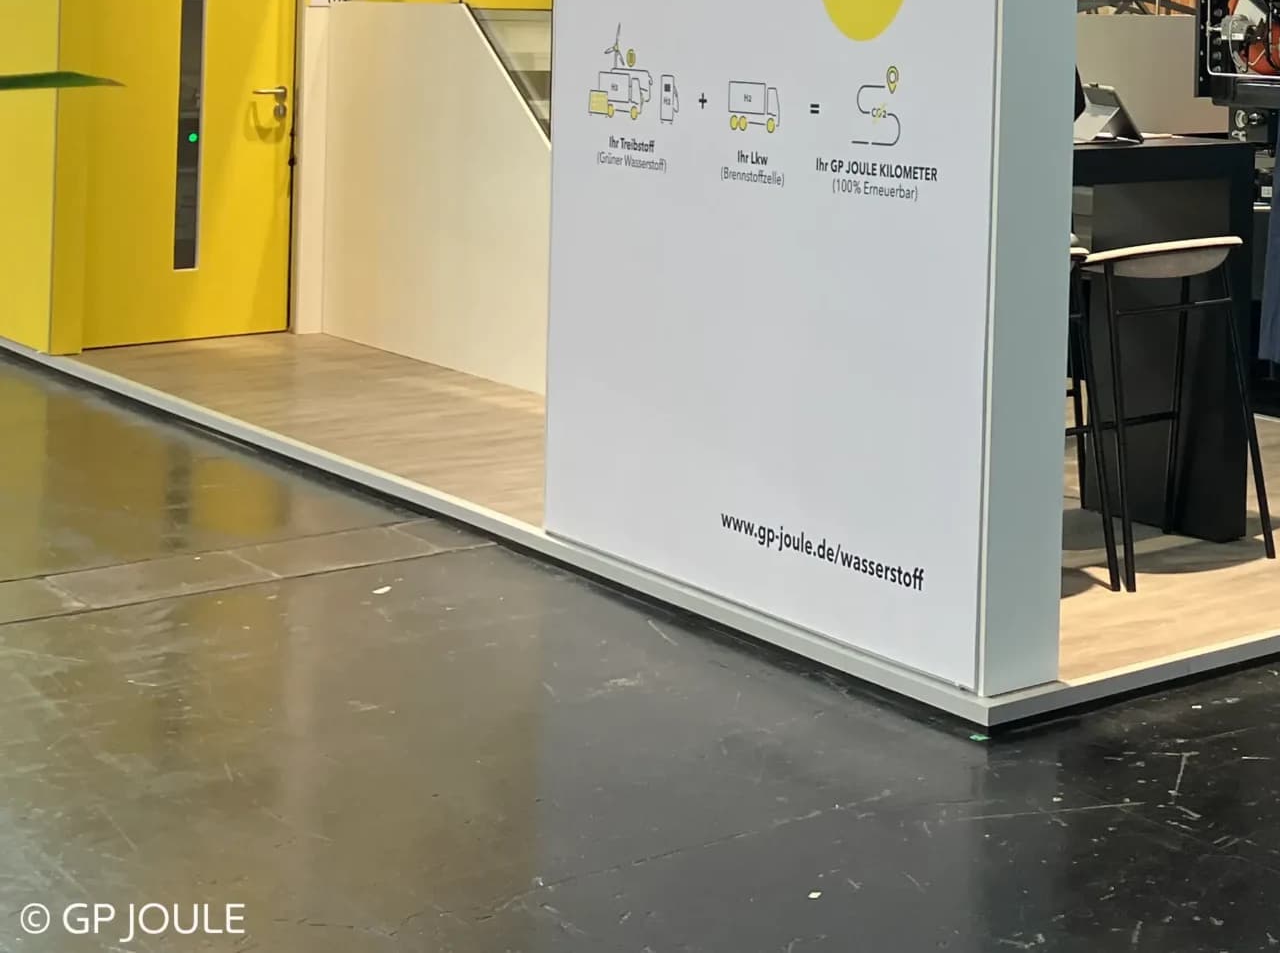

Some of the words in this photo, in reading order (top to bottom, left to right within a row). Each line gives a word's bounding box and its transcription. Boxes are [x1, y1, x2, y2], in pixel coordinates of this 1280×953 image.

[609, 135, 619, 149] Ihr
[620, 137, 655, 153] Treibstoff
[737, 150, 749, 164] Ihr
[750, 151, 768, 166] Lkw
[720, 166, 785, 188] (Brennstoffzelle)
[816, 157, 829, 172] Ihr
[830, 160, 844, 173] GP
[845, 161, 878, 177] JOULE
[879, 164, 938, 182] KILOMETER
[832, 178, 861, 195] (100%
[863, 181, 919, 201] Erneuerbar)
[721, 512, 924, 591] www.gp-joule.de/wasserstoff
